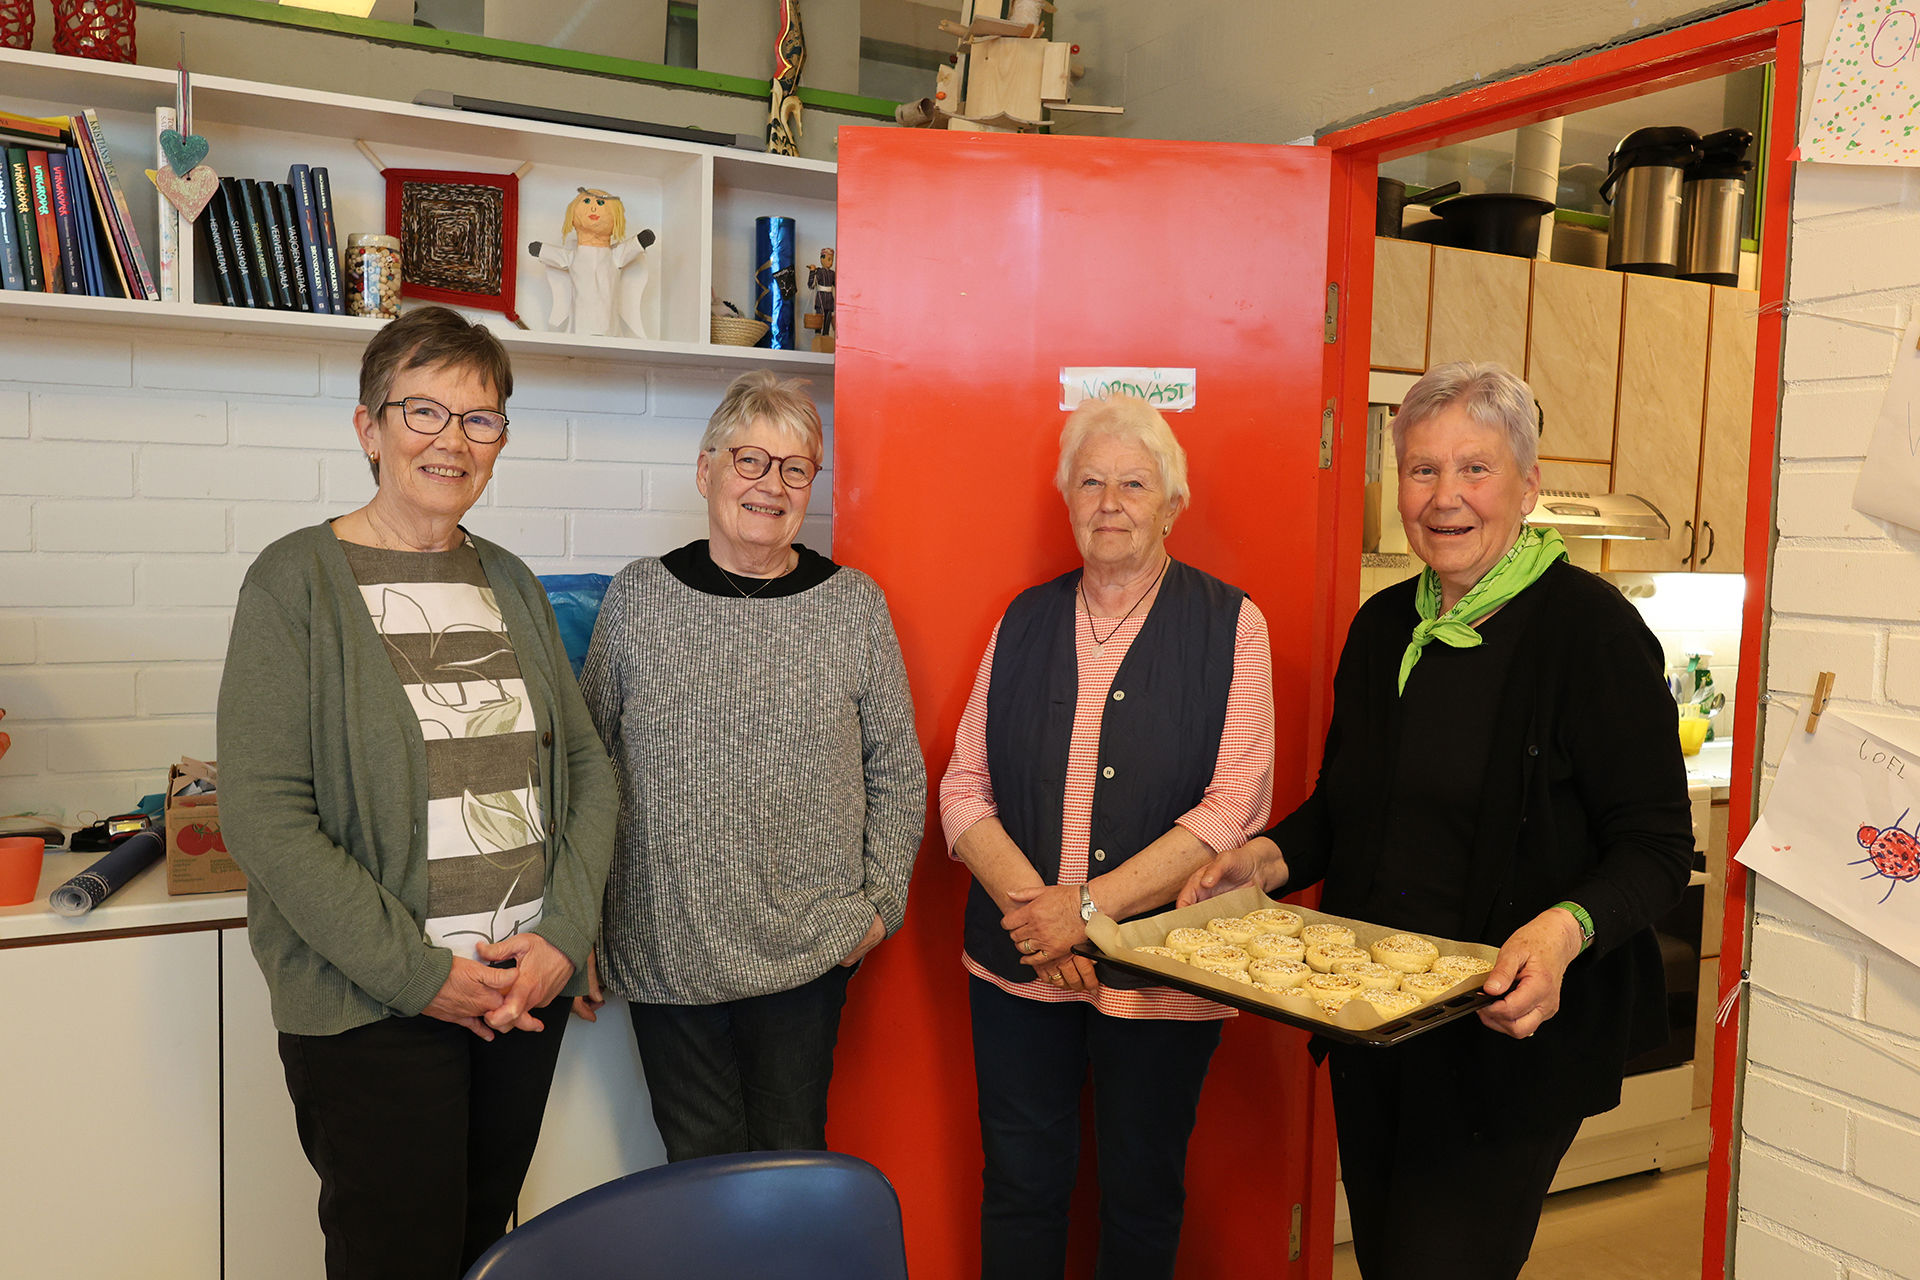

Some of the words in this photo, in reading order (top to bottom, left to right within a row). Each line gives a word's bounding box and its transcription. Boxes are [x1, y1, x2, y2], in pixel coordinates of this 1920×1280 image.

[271, 224, 285, 269] VERIVELJEN
[279, 269, 289, 289] VALA
[288, 225, 301, 264] VARJOJEN
[294, 264, 307, 293] VALTIAS
[310, 245, 322, 289] BRONSDOLKEN
[327, 247, 339, 292] BRONSDOLKEN
